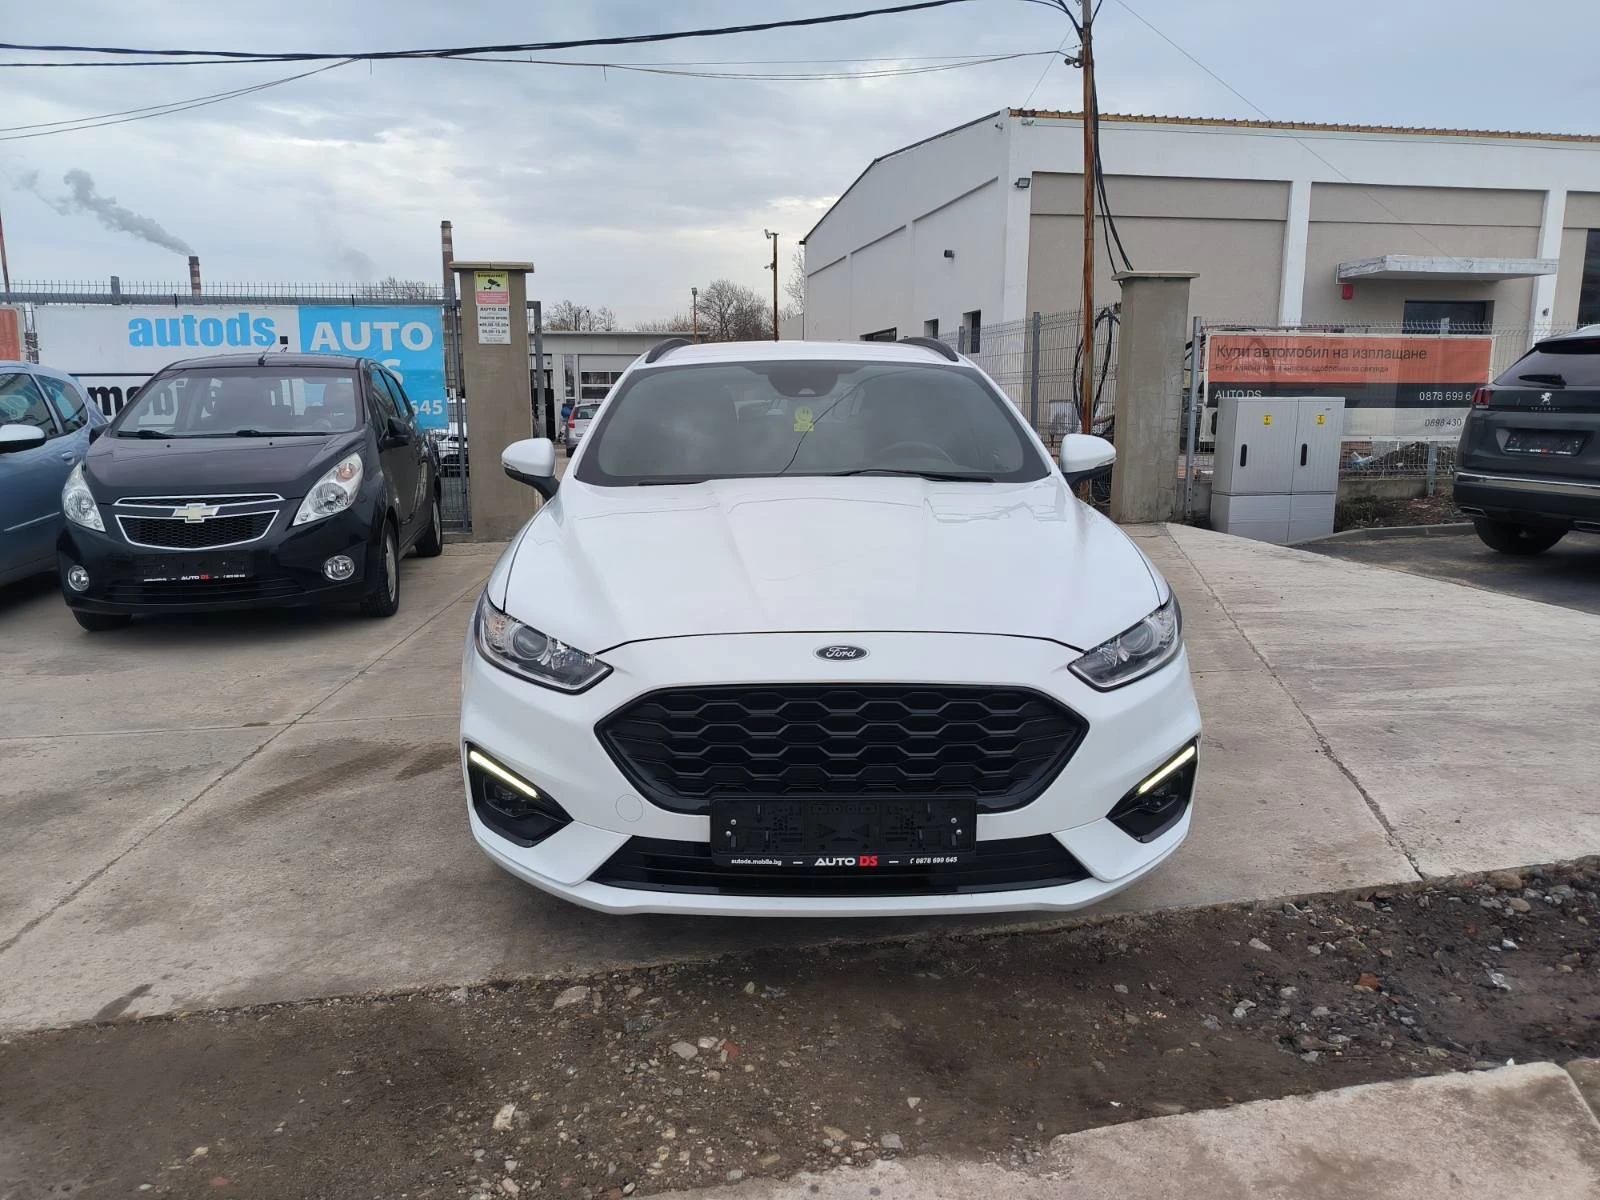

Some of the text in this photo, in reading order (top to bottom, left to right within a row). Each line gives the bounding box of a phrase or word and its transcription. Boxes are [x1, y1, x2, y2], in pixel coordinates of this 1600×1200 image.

[310, 320, 433, 351] AUTO
[1216, 345, 1427, 360] Купи автомобил на изплащане
[1215, 389, 1244, 399] AUTO
[1419, 391, 1443, 401] 0878
[1445, 391, 1464, 401] 699
[826, 646, 857, 658] Ford
[814, 857, 855, 867] AUTO
[859, 856, 878, 866] DS
[916, 857, 932, 865] 0878
[946, 856, 958, 864] 645
